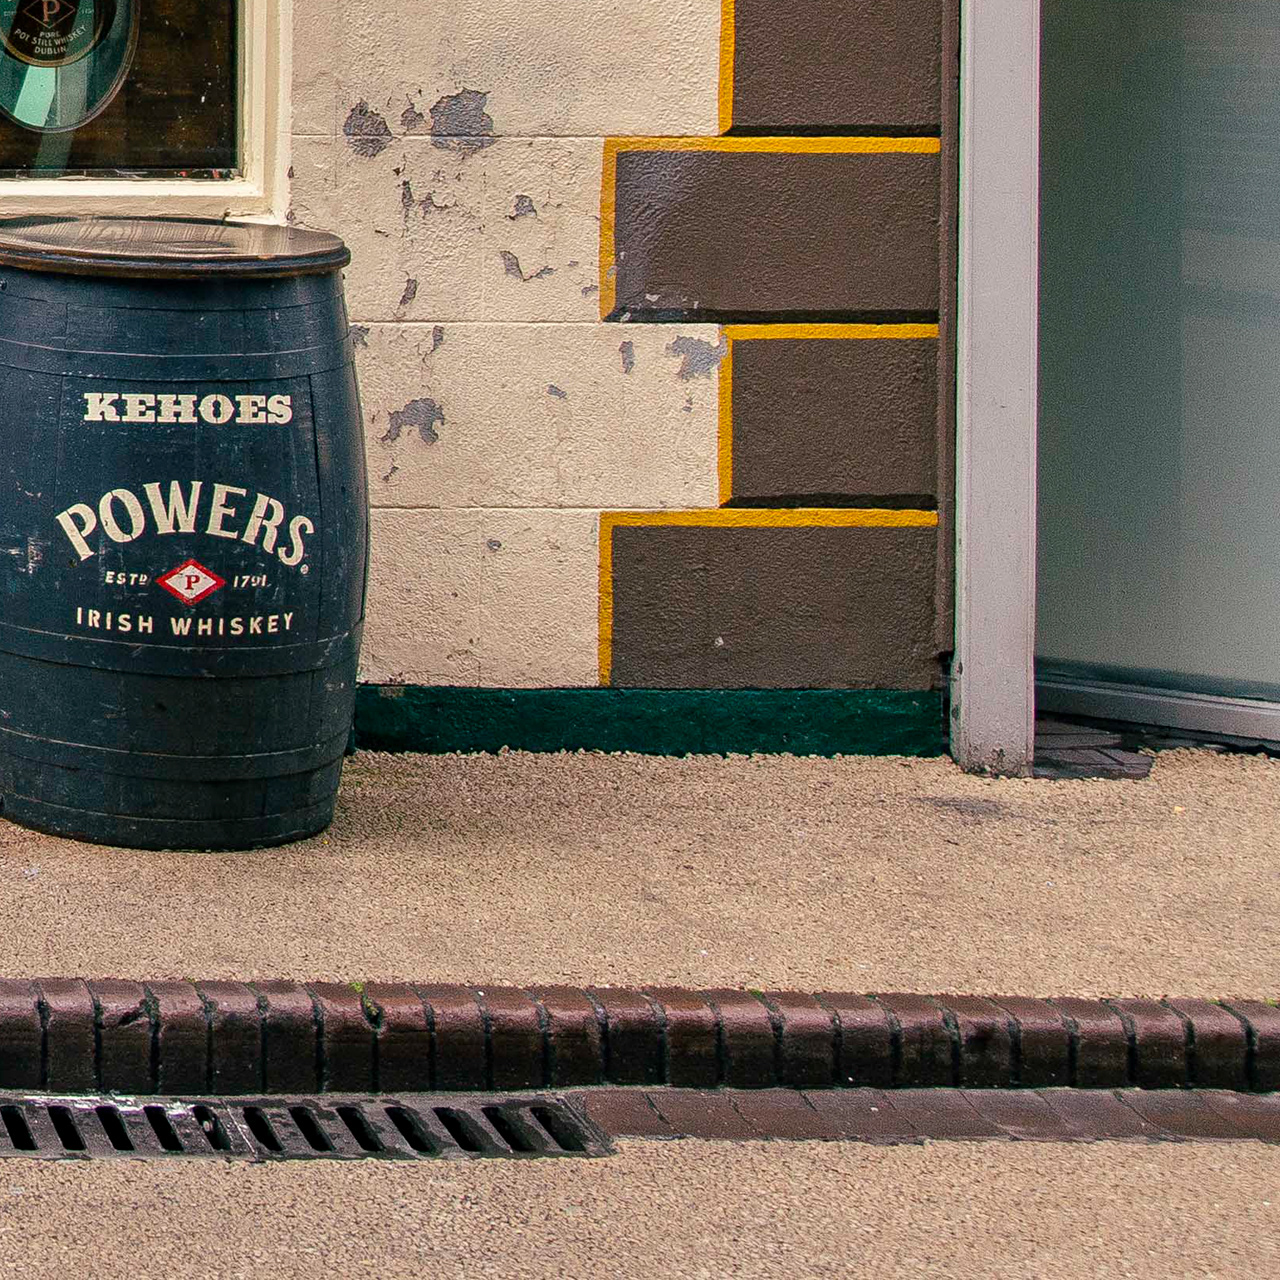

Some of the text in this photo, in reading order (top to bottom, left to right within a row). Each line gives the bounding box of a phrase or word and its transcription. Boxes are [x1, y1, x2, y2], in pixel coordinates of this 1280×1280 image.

[42, 0, 60, 22] P
[14, 25, 86, 46] POT STILL WHISKEY
[35, 46, 67, 54] DUBLIN
[84, 392, 293, 424] KEHOES
[55, 480, 315, 566] POWERS
[185, 575, 200, 590] P
[233, 574, 267, 587] 1791
[76, 606, 293, 635] IRISH WHISKEY
